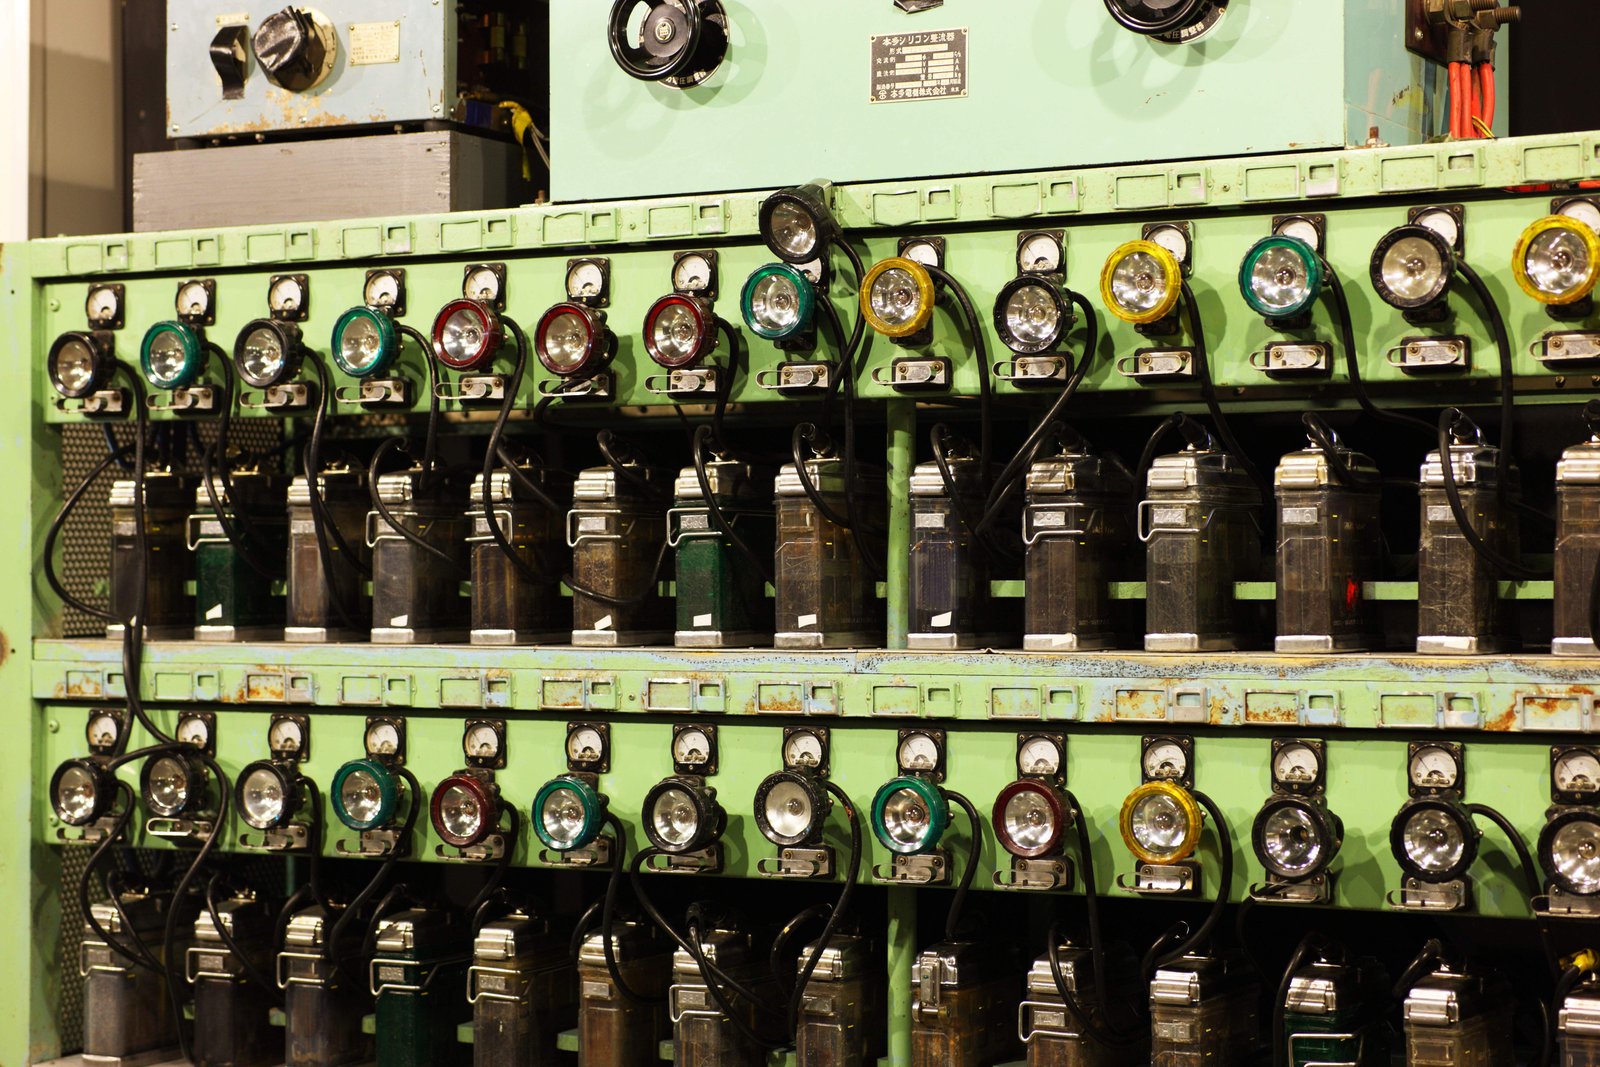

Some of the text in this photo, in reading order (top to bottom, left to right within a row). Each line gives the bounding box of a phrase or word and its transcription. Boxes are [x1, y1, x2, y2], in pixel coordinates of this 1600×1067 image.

[882, 32, 954, 46] 本多シリコン整流器
